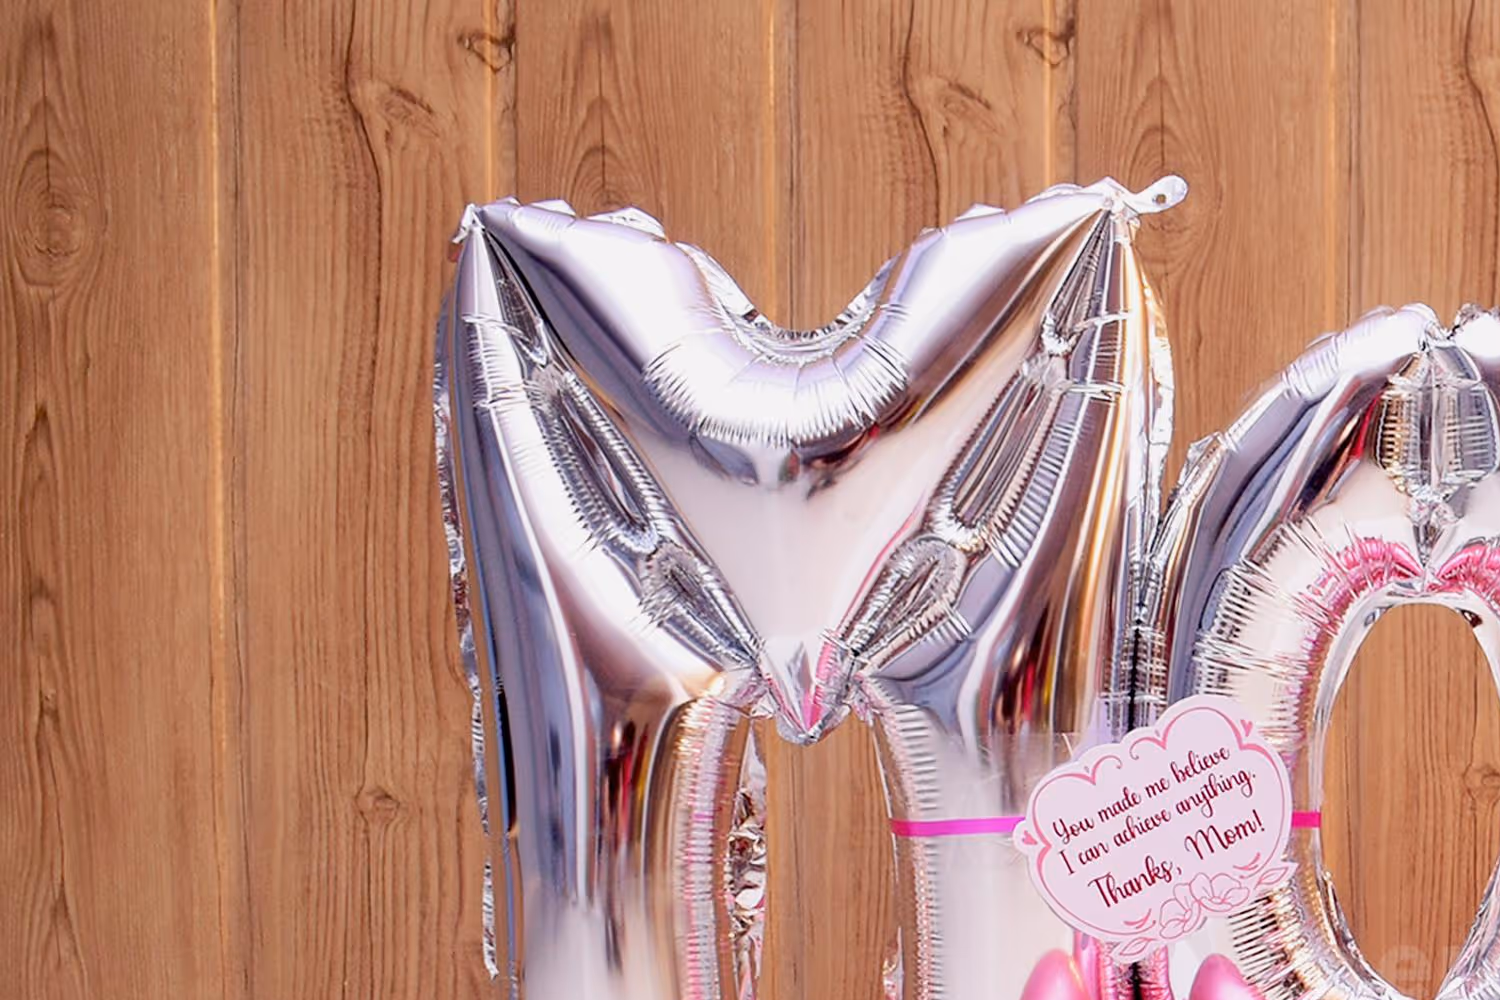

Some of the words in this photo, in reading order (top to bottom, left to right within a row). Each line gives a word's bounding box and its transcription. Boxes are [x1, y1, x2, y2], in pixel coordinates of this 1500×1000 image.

[1052, 817, 1095, 845] You
[1098, 787, 1142, 823] made
[1145, 777, 1171, 800] me
[1170, 747, 1230, 784] believe
[1058, 850, 1075, 875] I
[1078, 843, 1110, 867] can
[1113, 811, 1173, 848] achieve
[1175, 767, 1257, 818] anything.
[1087, 855, 1183, 909] Thanks,
[1184, 809, 1266, 860] Mom!
